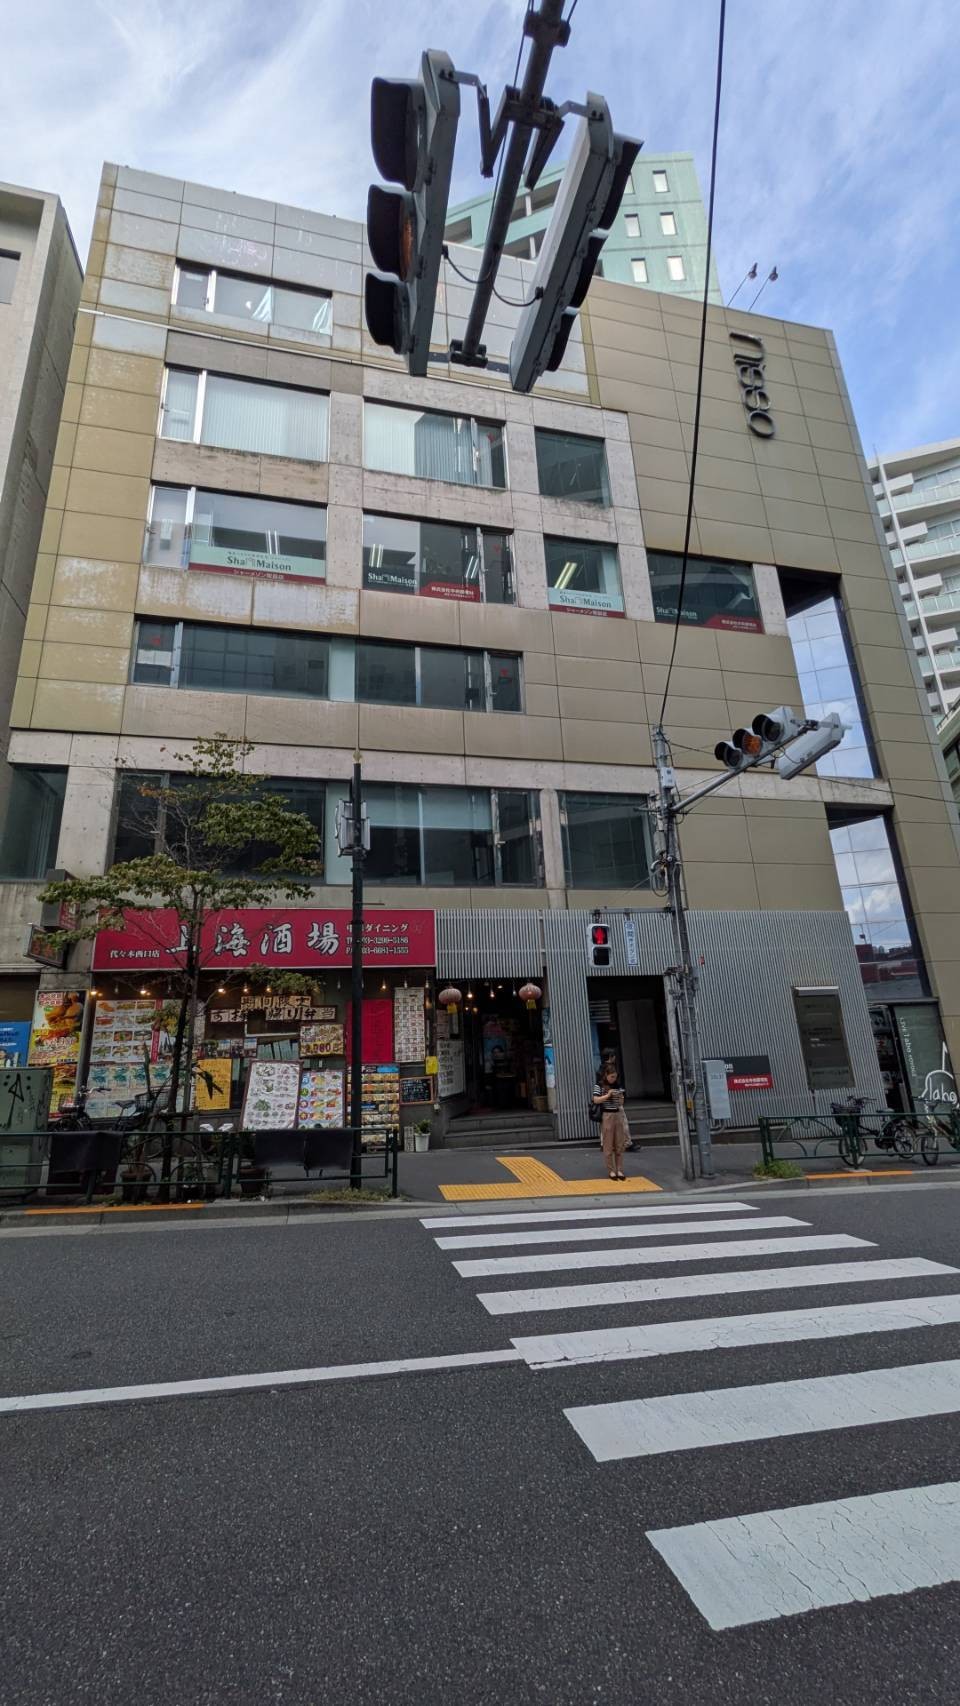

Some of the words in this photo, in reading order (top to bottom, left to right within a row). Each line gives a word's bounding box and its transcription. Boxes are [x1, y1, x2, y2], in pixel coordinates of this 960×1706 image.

[226, 555, 246, 566] Sha
[256, 559, 292, 571] Maison
[390, 575, 417, 585] Maison
[583, 599, 612, 608] Maison
[345, 922, 408, 932] 中ダイニング
[165, 920, 341, 957] 上海酒場
[110, 949, 160, 959] 代々木西口店
